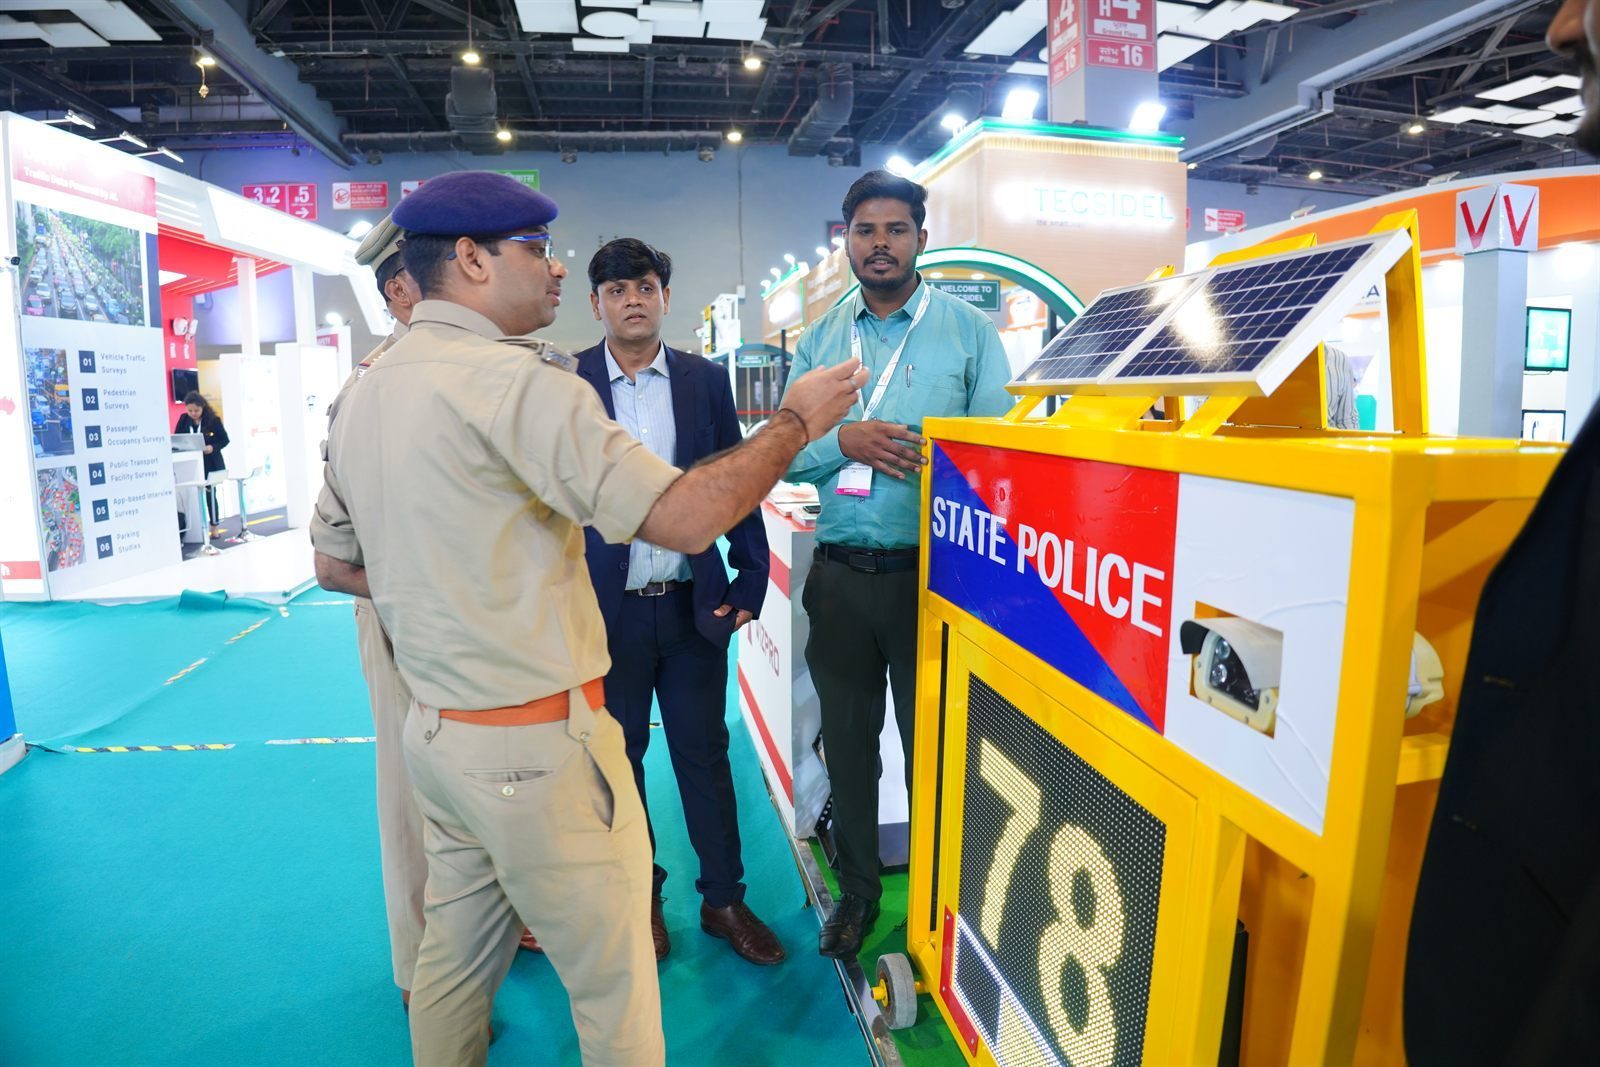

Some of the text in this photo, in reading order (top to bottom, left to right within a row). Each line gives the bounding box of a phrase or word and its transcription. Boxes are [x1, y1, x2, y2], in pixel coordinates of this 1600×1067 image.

[1064, 47, 1077, 72] 16
[1120, 44, 1143, 66] 16
[1033, 188, 1176, 221] TECSIDEL
[940, 284, 992, 293] WELCOME TO
[82, 358, 92, 367] 01
[100, 353, 146, 362] Vehicle Traffic
[101, 366, 127, 375] Surveys
[85, 395, 96, 404] 02
[104, 402, 130, 410] Surveys
[106, 425, 138, 433] Passenger
[88, 432, 99, 441] 03
[107, 435, 165, 446] Occupancy Surveys
[109, 457, 158, 469] Public Transport
[92, 469, 103, 479] 04
[111, 471, 158, 481] Facility Surveys
[113, 494, 146, 505] App-based
[96, 506, 106, 516] 05
[114, 508, 139, 518] Surveys
[116, 531, 140, 540] Parking
[118, 543, 141, 553] Studies
[932, 496, 1165, 638] STATE POLICE
[980, 736, 1124, 1067] 78
